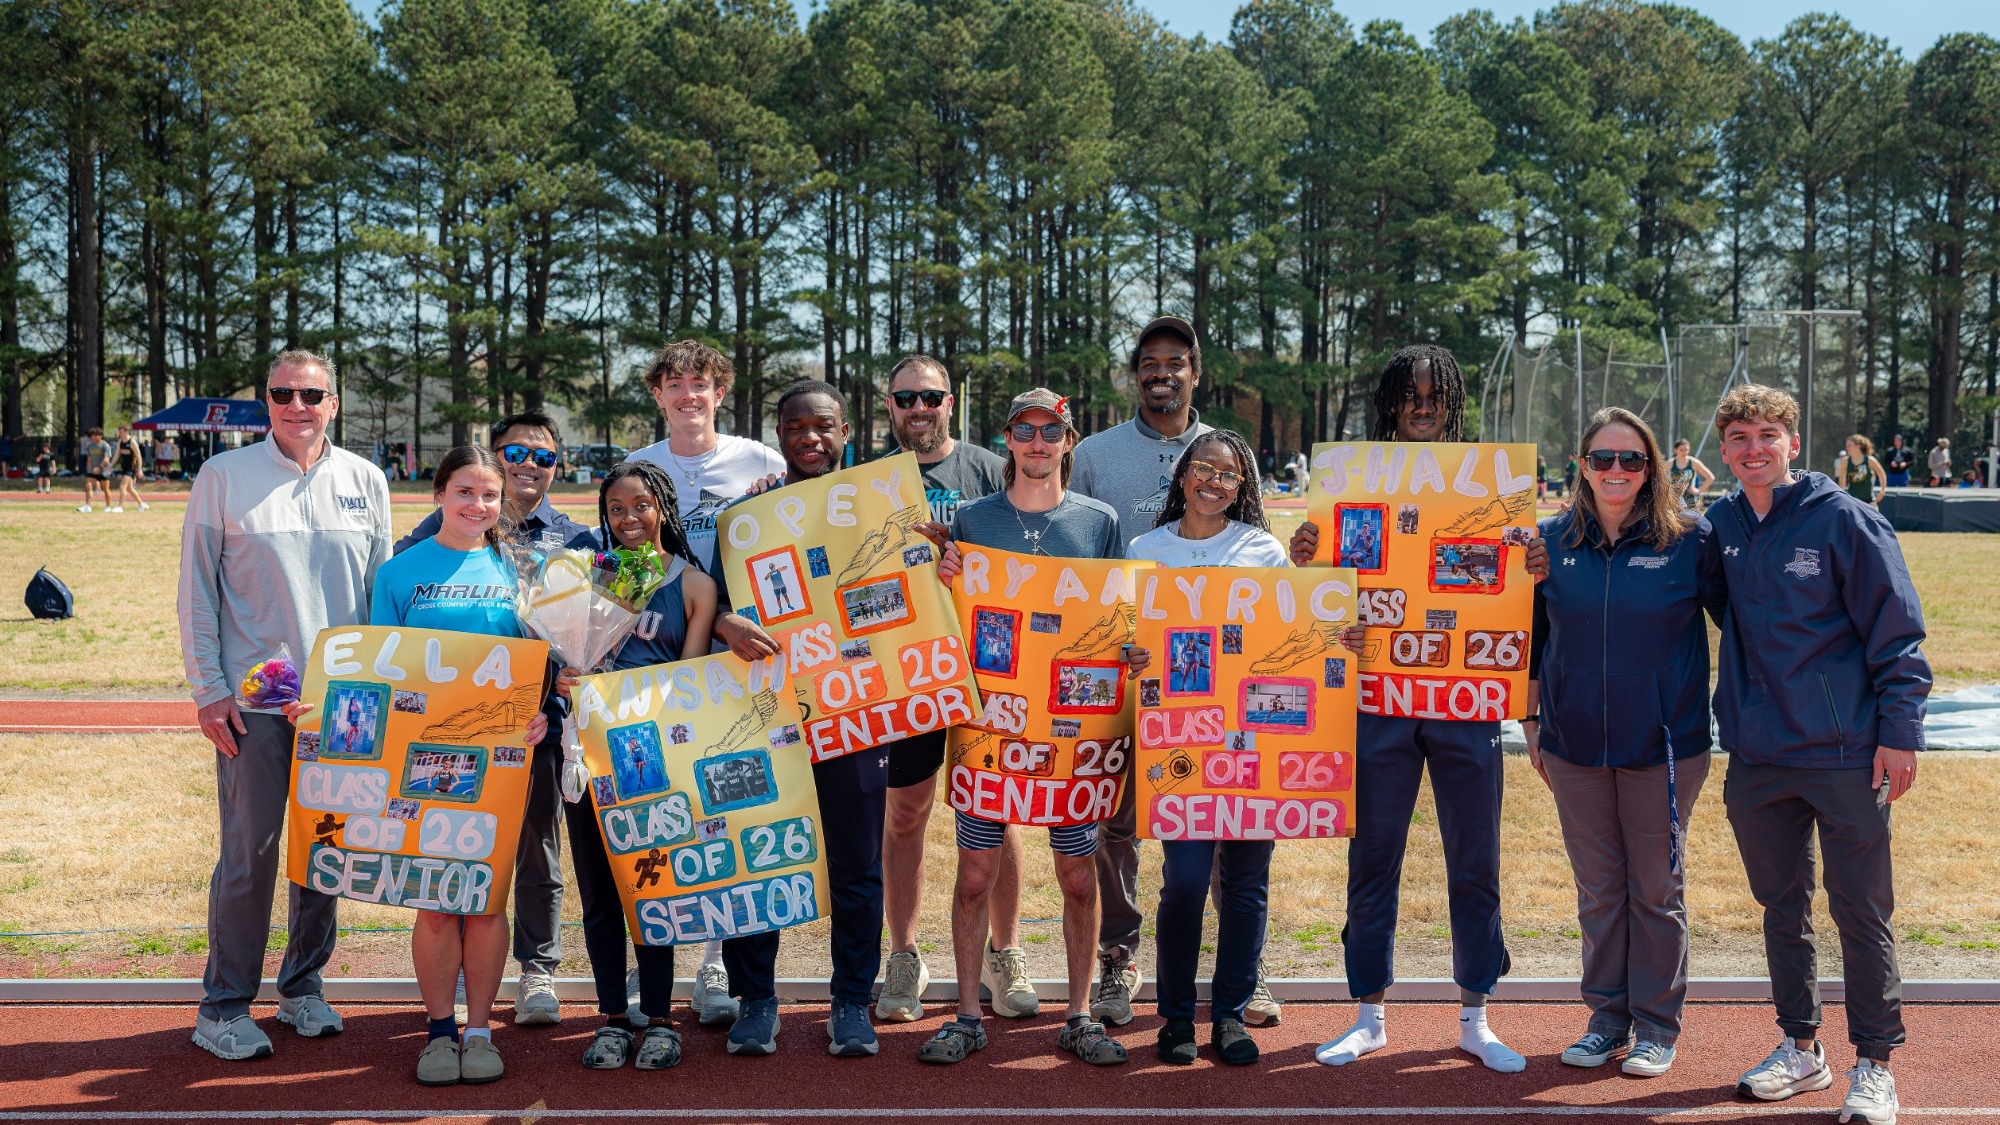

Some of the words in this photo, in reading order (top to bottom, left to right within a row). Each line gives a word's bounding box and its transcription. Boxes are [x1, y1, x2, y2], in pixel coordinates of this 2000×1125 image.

[202, 403, 230, 424] E
[1313, 444, 1533, 497] J-HALL
[728, 469, 905, 549] OPEY
[412, 583, 512, 607] MARLIN
[963, 551, 1136, 606] RYAN
[1142, 575, 1351, 624] LYRIC
[417, 602, 436, 610] CROSS
[1358, 590, 1405, 625] ASS
[323, 631, 513, 689] ELLA
[789, 622, 837, 674] ASS
[1393, 632, 1444, 664] OF
[578, 652, 787, 729] ANISAH
[821, 661, 877, 709] OF
[1357, 674, 1506, 720] ENIOR
[809, 687, 972, 761] ENIOR
[970, 693, 1027, 733] ASS
[1140, 708, 1224, 746] CLASS
[1004, 742, 1050, 771] OF
[1205, 752, 1259, 784] OF
[301, 766, 386, 809] CLASS
[951, 765, 1116, 824] SENIOR
[348, 817, 401, 849] OF
[604, 795, 692, 850] CLASS
[1152, 794, 1337, 840] SENIOR
[312, 847, 493, 914] SENIOR
[674, 842, 726, 882] OF
[641, 874, 813, 946] SENIOR
